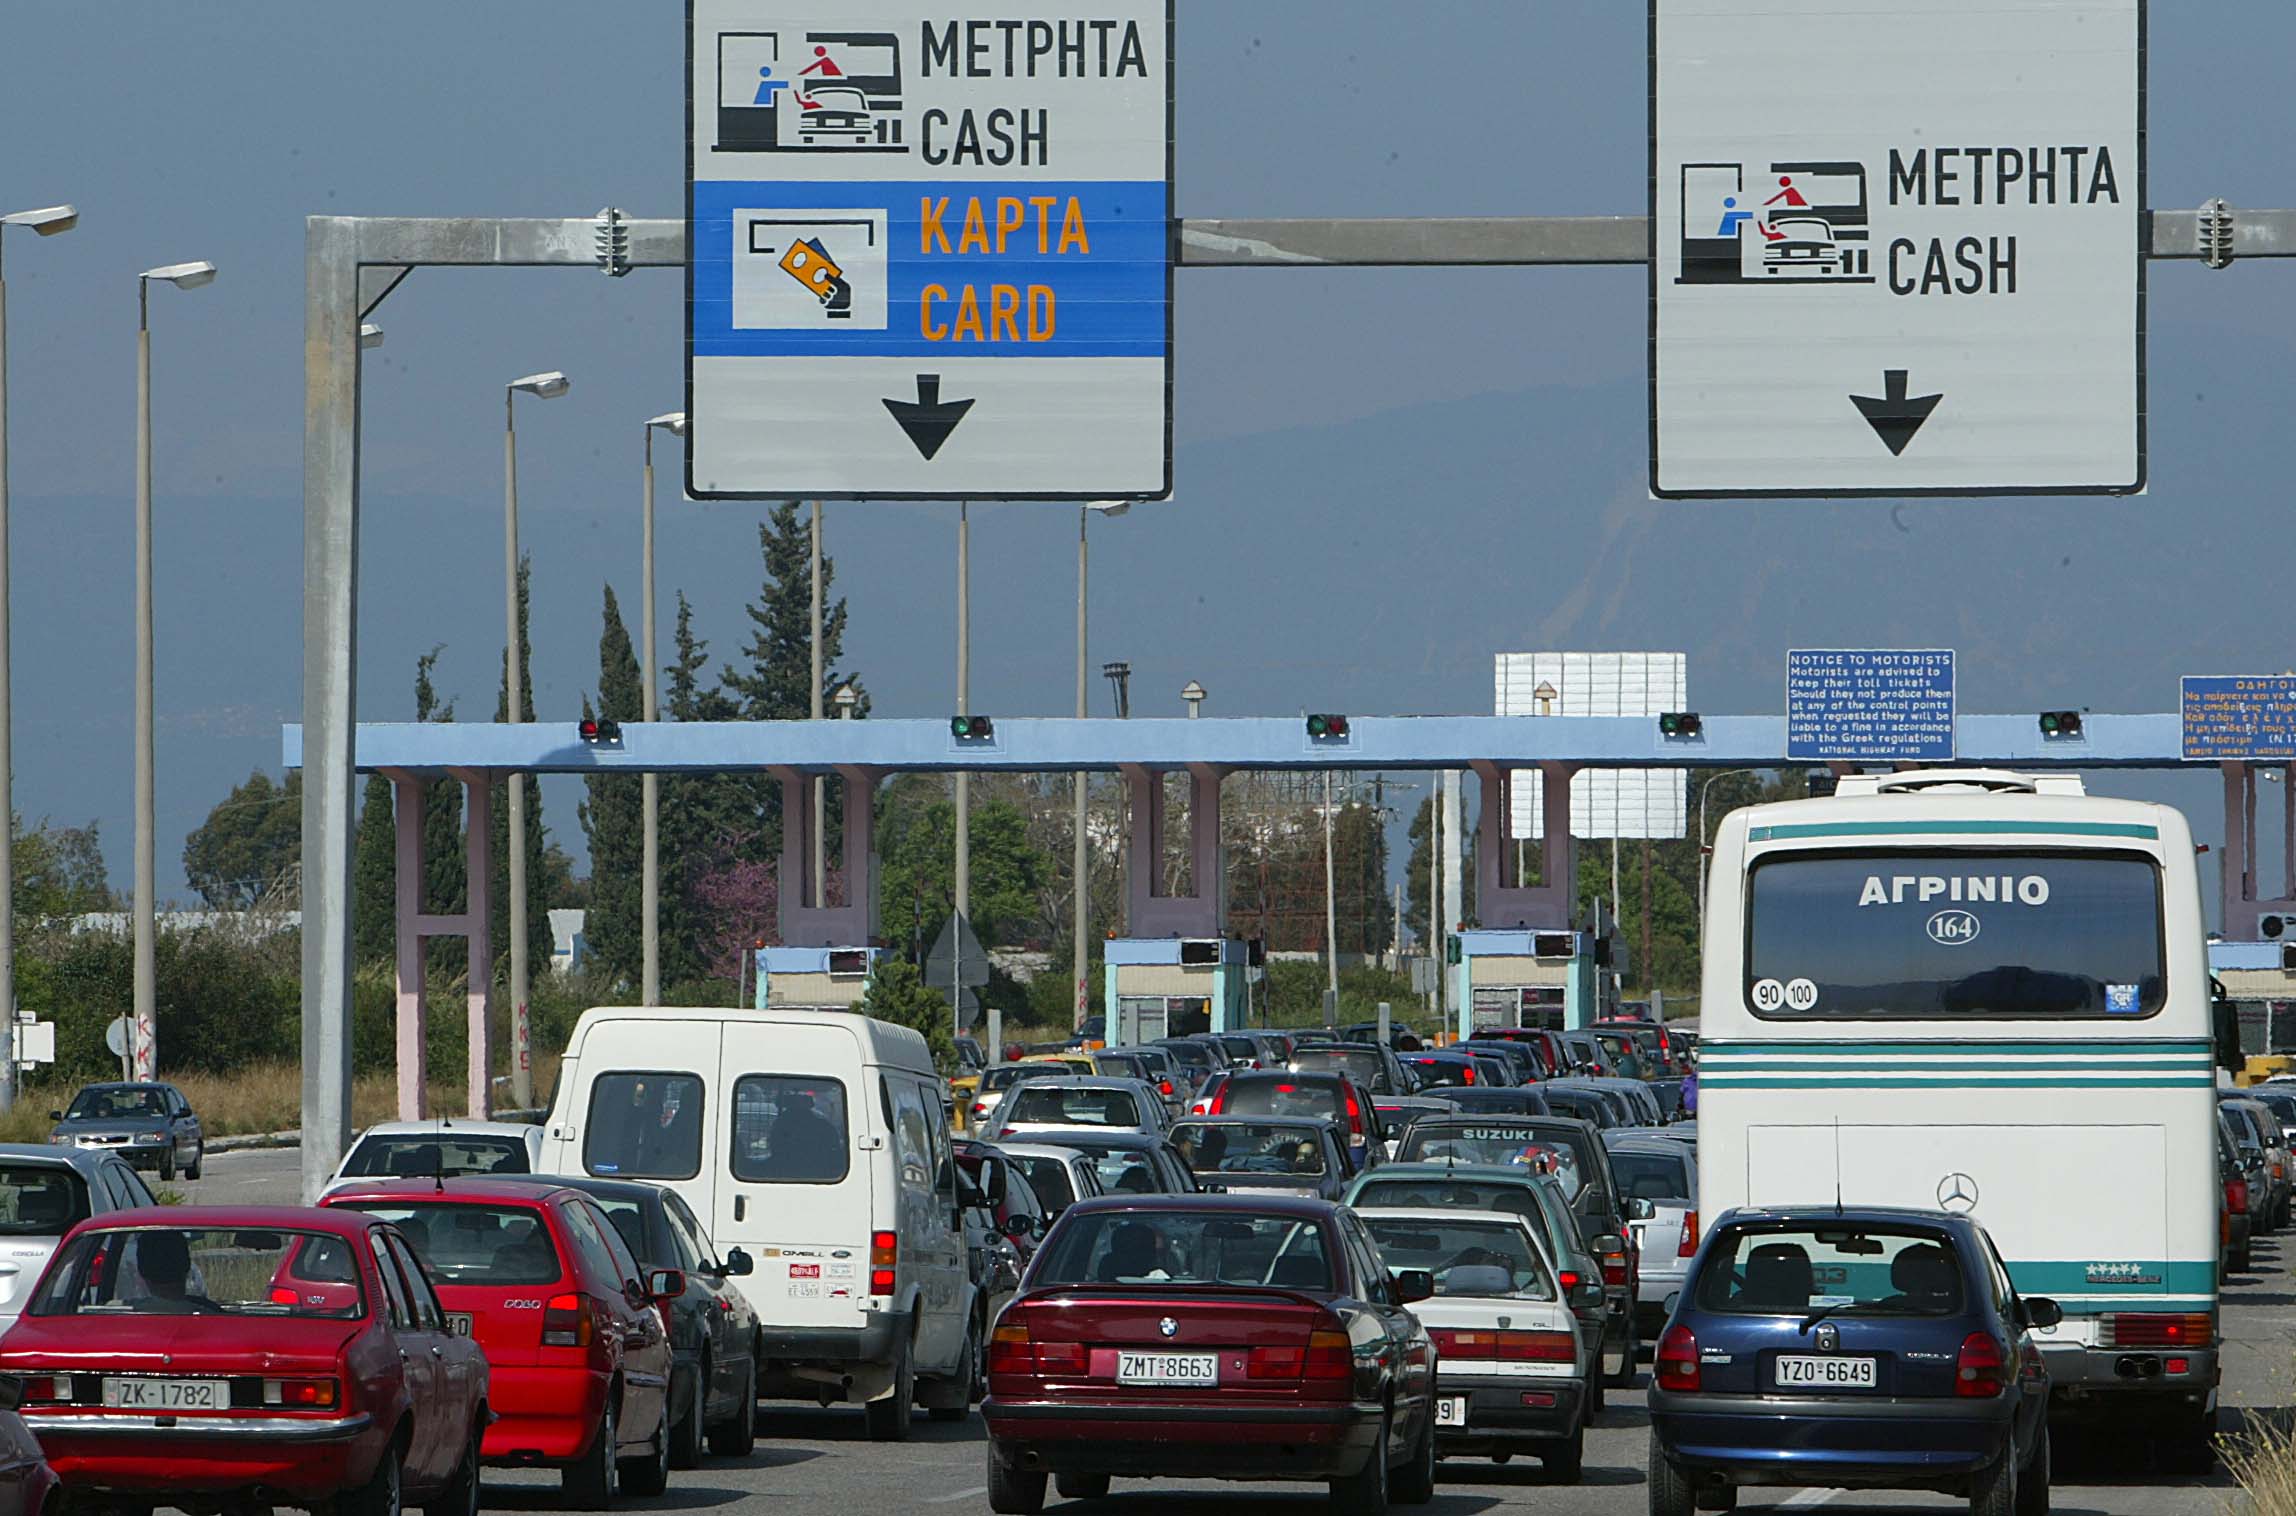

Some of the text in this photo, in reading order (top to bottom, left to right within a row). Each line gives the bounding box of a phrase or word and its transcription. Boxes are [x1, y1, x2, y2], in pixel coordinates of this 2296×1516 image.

[922, 20, 1147, 77] ΜΕΤΡΗΤΑ
[922, 109, 1049, 166] CASH
[1889, 146, 2120, 206] ΜΕΤΡΗΤΑ
[920, 197, 1089, 255] ΚΑΡΤΑ
[1889, 236, 2017, 296] CASH
[921, 284, 1056, 341] CARD
[1791, 655, 1950, 664] NOTICE TO MOTORISTS
[1791, 667, 1940, 676] Motorists are advised to
[1791, 679, 1931, 688] Keep their toll tickets
[1791, 690, 1951, 699] Should they not produce them
[1792, 701, 1948, 711] at any of the control points
[1792, 712, 1818, 722] when
[1882, 712, 1905, 722] they
[1911, 712, 1931, 722] will
[1936, 712, 1949, 722] be
[1791, 723, 1950, 732] liable to a fine in accordance
[1791, 733, 1943, 743] with the Greek regulations
[1859, 875, 2050, 906] ΑΓΡΙΝΙΟ
[1934, 917, 1973, 938] 164
[1760, 985, 1779, 1005] 90
[1791, 985, 1812, 1003] 100
[1463, 1129, 1534, 1140] SUZUKI
[503, 1299, 542, 1309] POLO
[121, 1383, 212, 1406] ZK-1782
